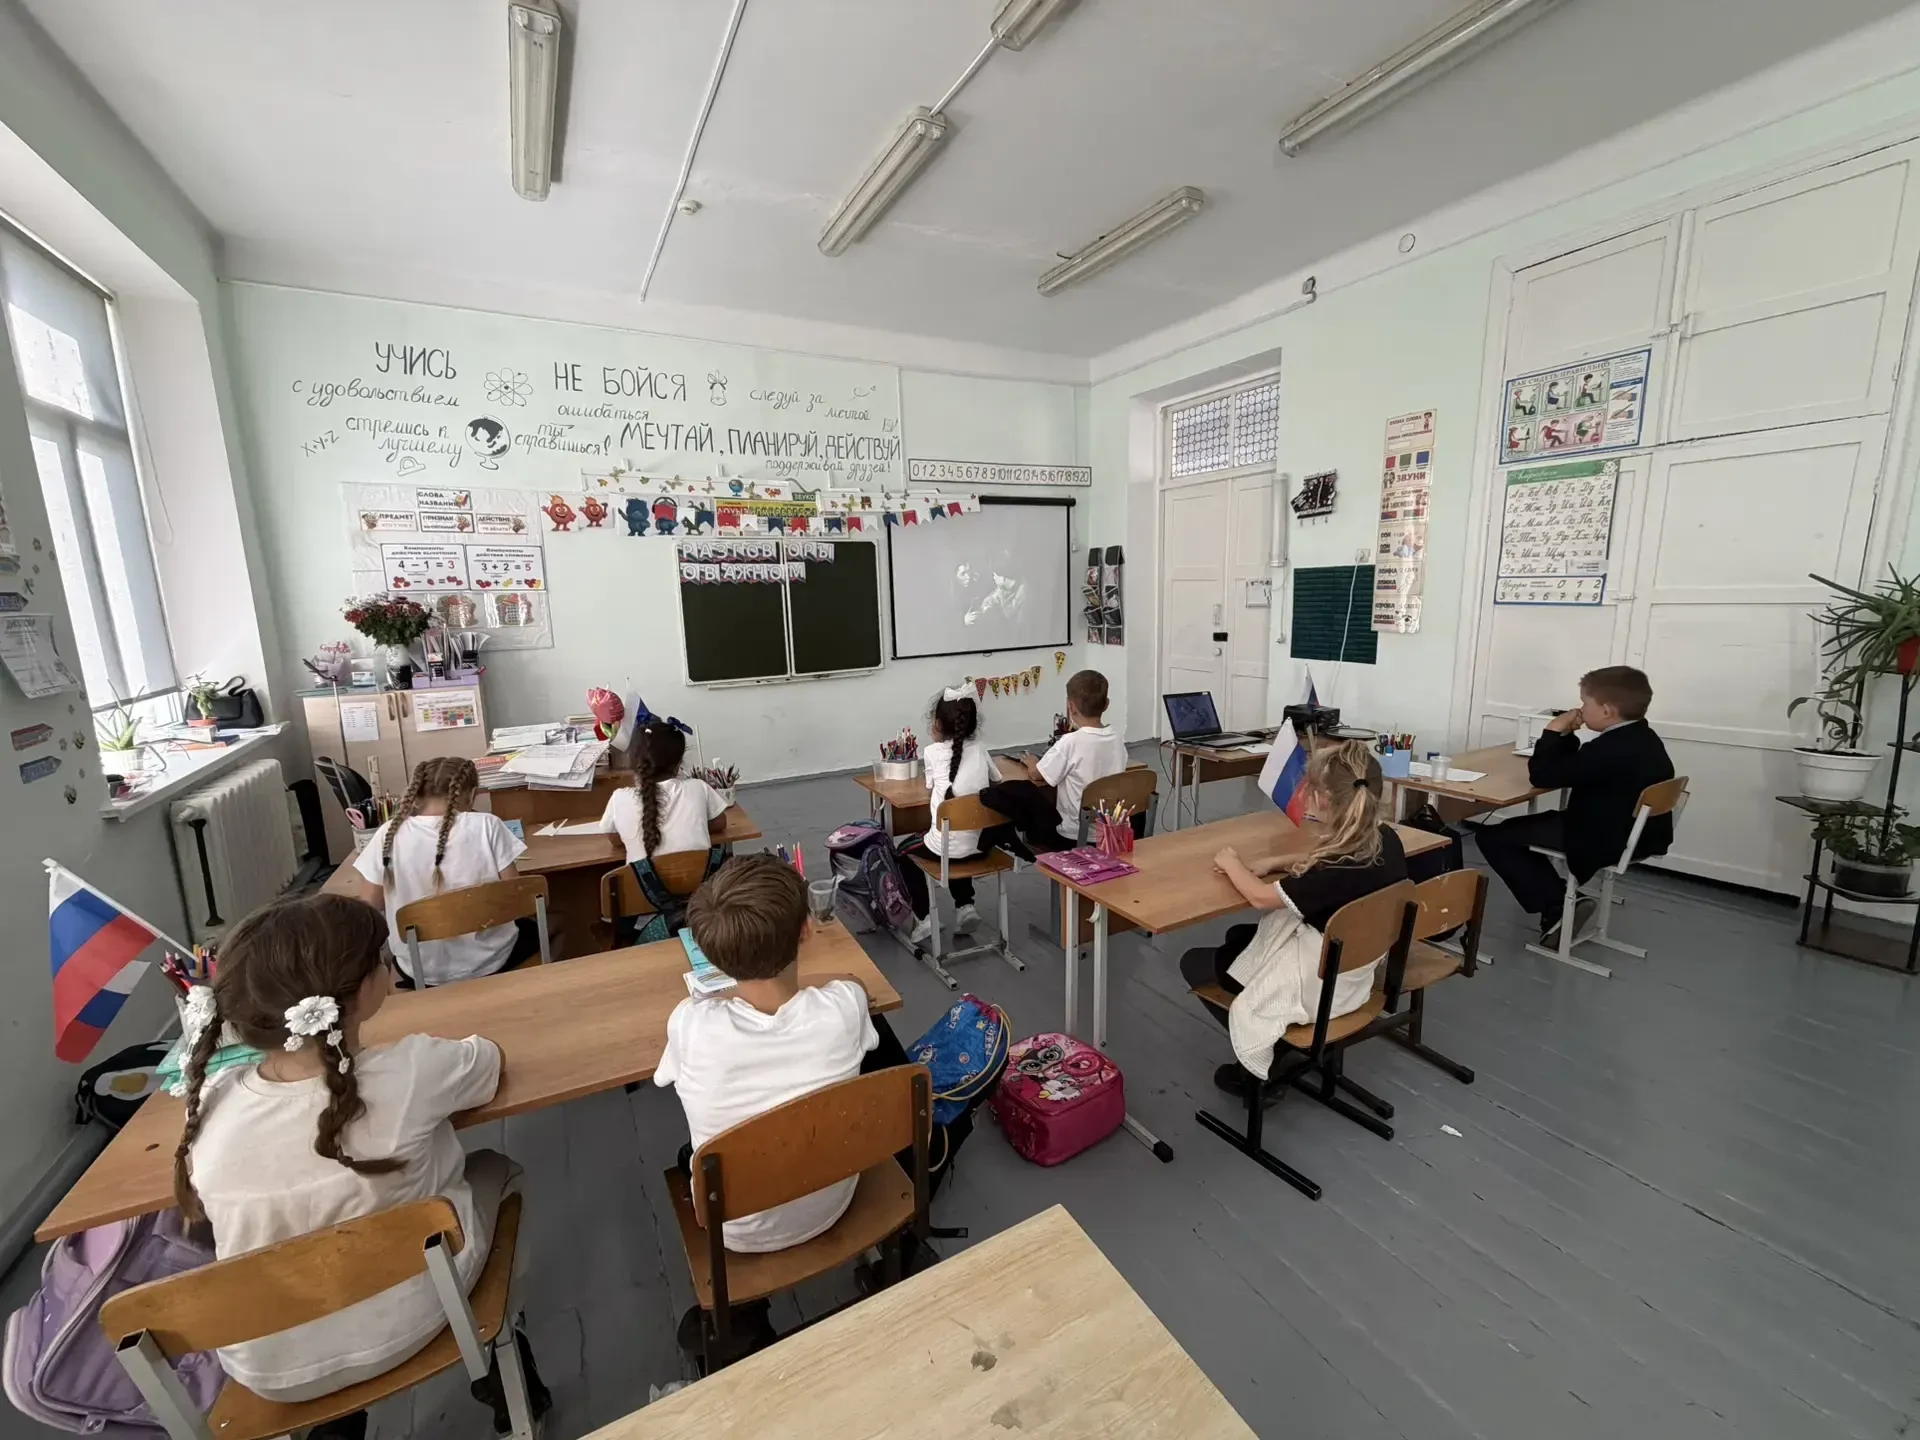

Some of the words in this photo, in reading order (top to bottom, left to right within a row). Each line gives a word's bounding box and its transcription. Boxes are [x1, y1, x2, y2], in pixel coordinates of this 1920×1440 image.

[375, 342, 456, 379] УЧИСЬ
[1560, 361, 1611, 379] ПРАВИЛЬНО
[554, 361, 583, 392] НЕ
[602, 366, 687, 402] БОЙСЯ
[292, 379, 302, 393] с
[307, 378, 460, 407] удовольствием
[750, 388, 800, 410] следуй
[805, 392, 824, 412] за
[558, 403, 650, 421] ошибаться
[824, 407, 870, 421] мечтой
[345, 416, 429, 440] стремись
[378, 437, 464, 468] лучшему
[728, 428, 824, 461] ПЛАНИРУЙ,
[824, 434, 901, 461] ДЕЙСТВУЙ
[765, 458, 844, 472] поддерживай
[912, 464, 919, 476] 0
[922, 465, 926, 476] 1
[929, 465, 936, 477] 2
[939, 465, 945, 477] 3
[947, 466, 953, 477] 4
[957, 466, 962, 478] 5
[966, 467, 972, 478] 6
[973, 467, 979, 478] 7
[982, 467, 987, 479] 8
[990, 468, 996, 479] 9
[1396, 471, 1426, 483] ЗВУКИ
[682, 542, 834, 559] РАЗГОВОРЫ
[424, 561, 429, 569] 1
[448, 561, 455, 569] 3
[481, 563, 488, 571] 3
[504, 563, 510, 571] 2
[525, 563, 531, 571] 5
[683, 565, 696, 580] О
[704, 564, 804, 580] ВАЖНОМ
[1557, 580, 1566, 588] 0
[1577, 580, 1583, 588] 1
[1594, 580, 1601, 588] 2
[1528, 592, 1535, 600] 5
[1543, 592, 1550, 600] 6
[1592, 593, 1599, 601] 9
